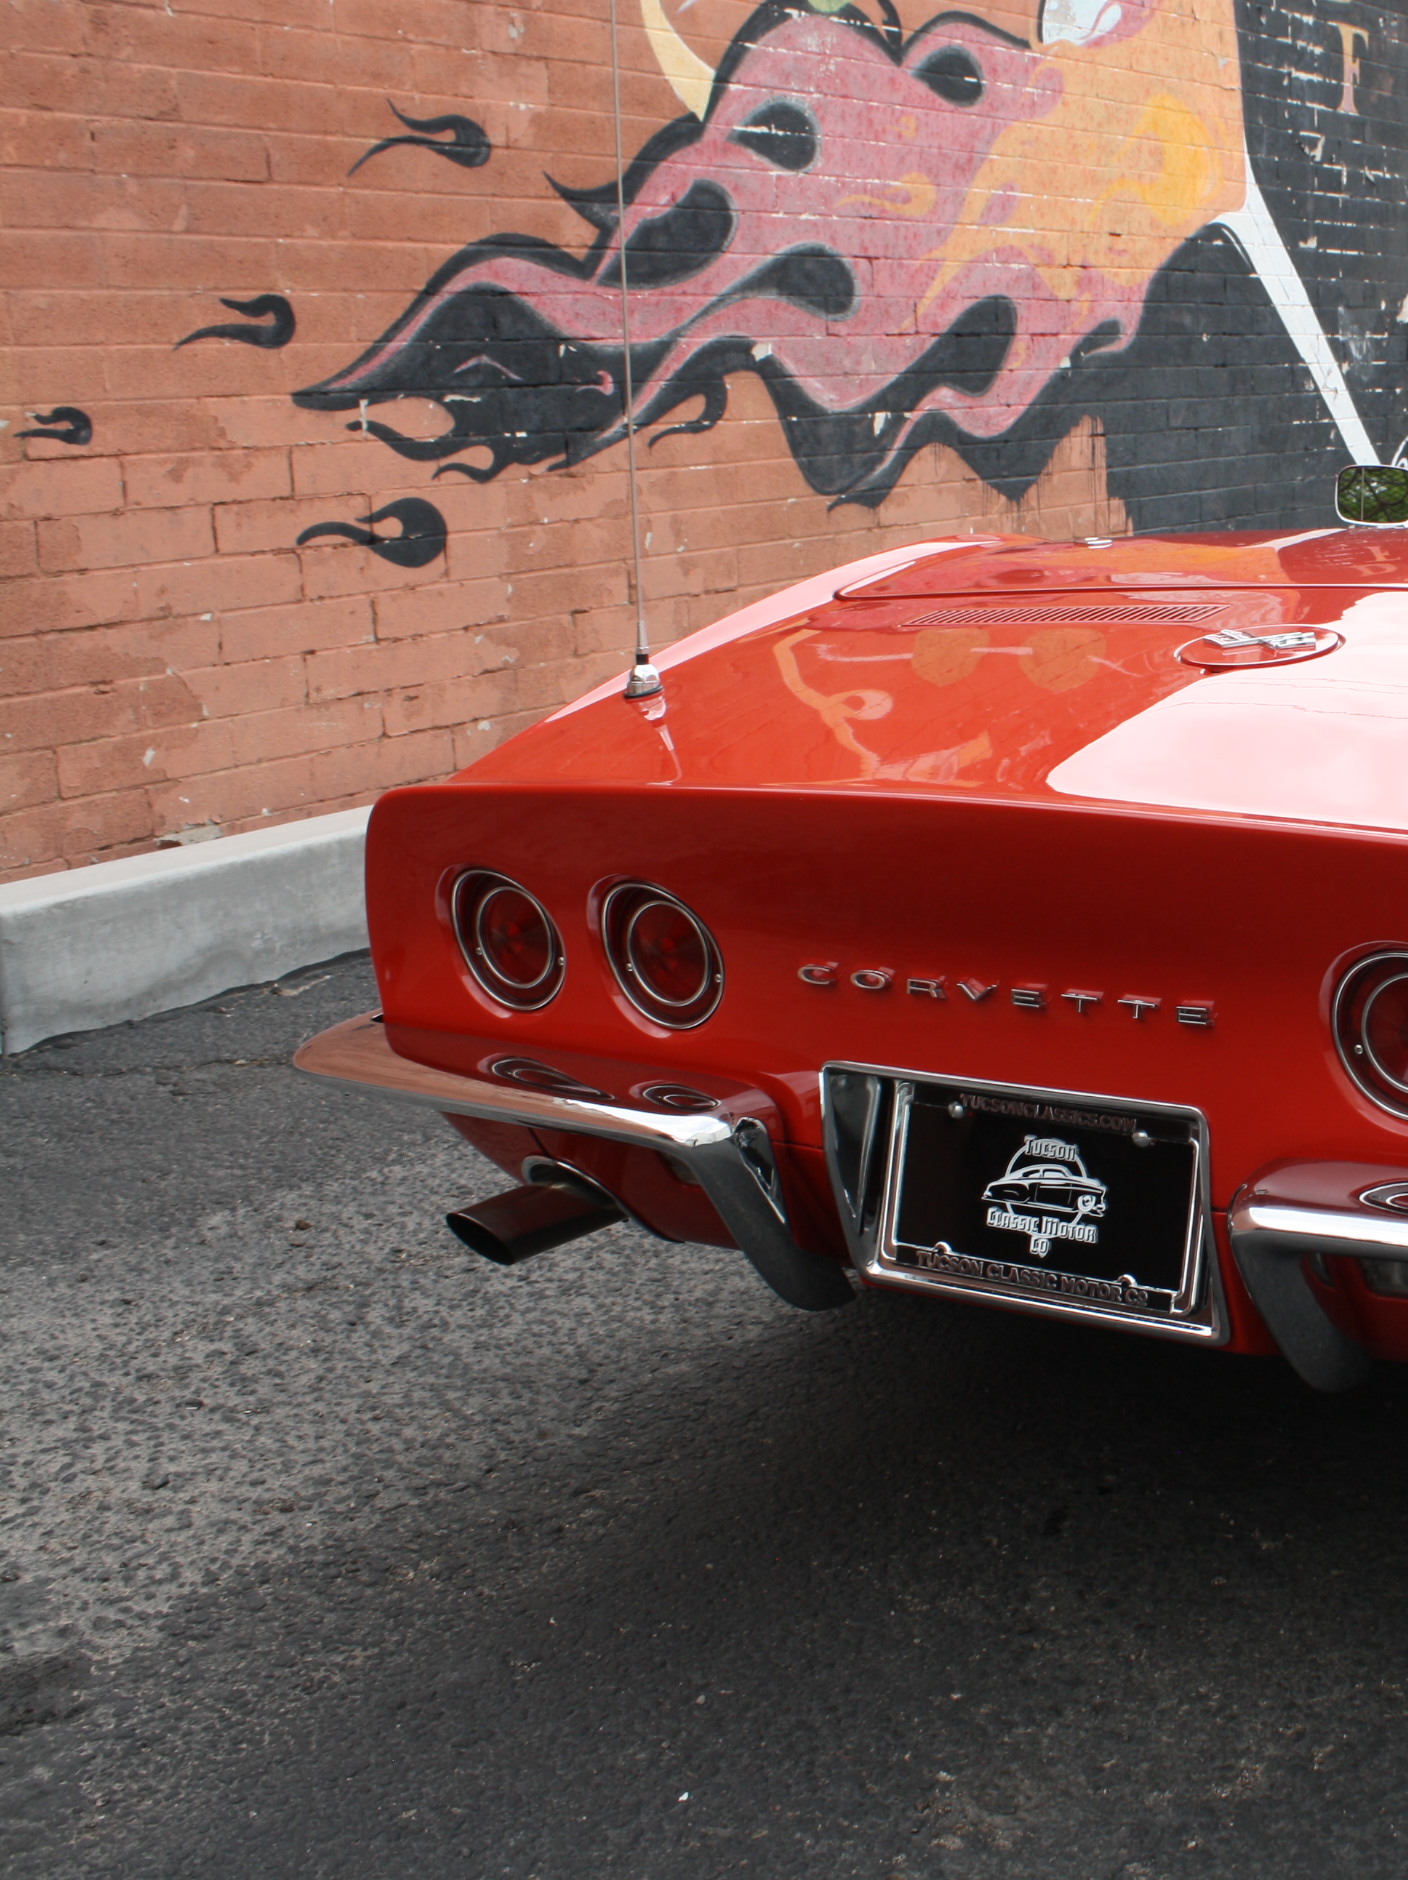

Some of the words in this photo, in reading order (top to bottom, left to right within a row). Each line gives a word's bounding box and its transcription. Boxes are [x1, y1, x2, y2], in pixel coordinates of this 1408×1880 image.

[797, 961, 1217, 1030] CORVETTE
[959, 1092, 1138, 1133] TUCSONCLASSICS.COM
[916, 1250, 984, 1278] TUCSON
[986, 1264, 1058, 1292] CLASSIC
[1060, 1274, 1122, 1304] MOTOR
